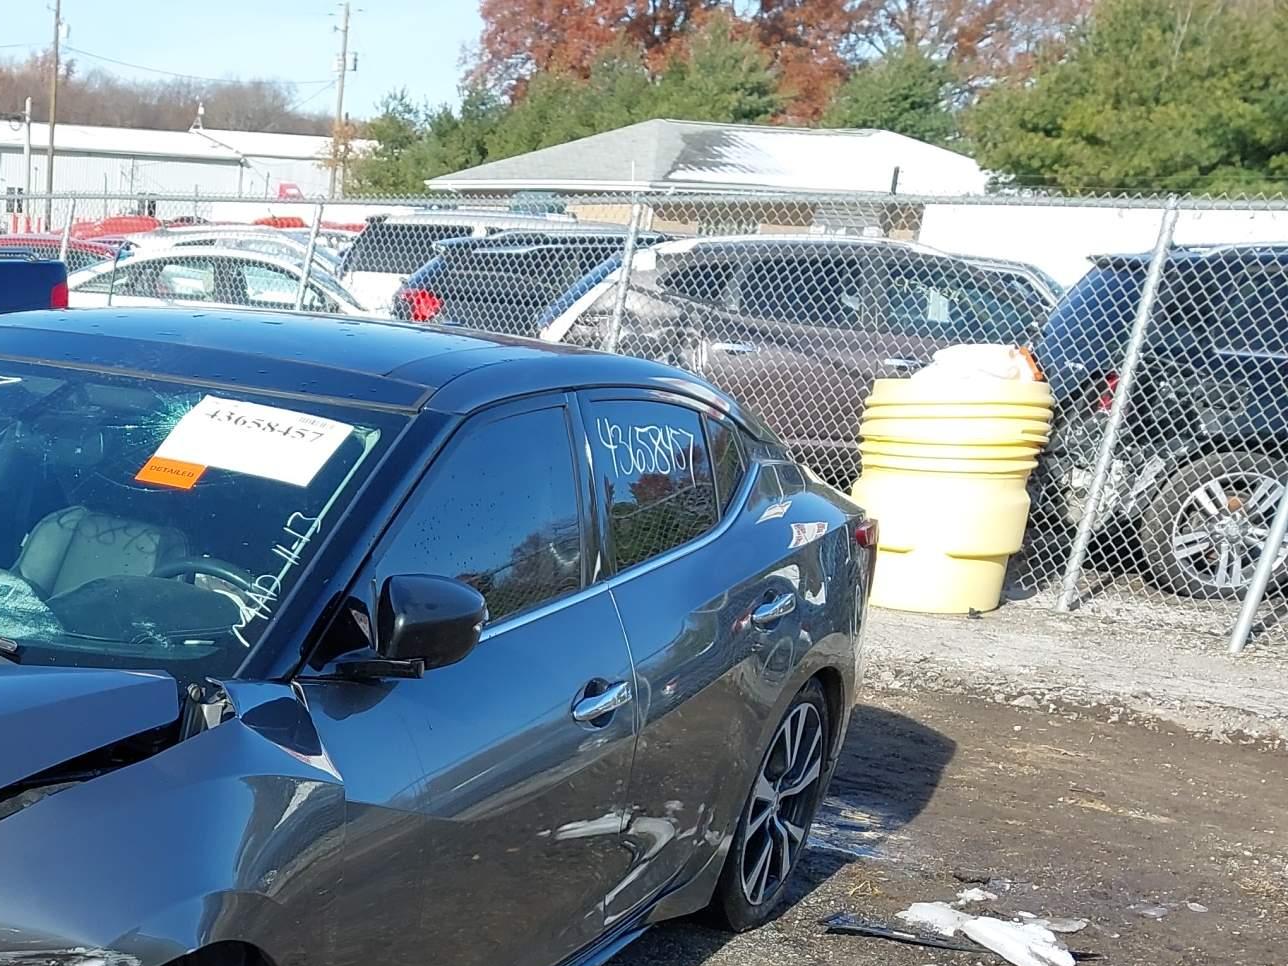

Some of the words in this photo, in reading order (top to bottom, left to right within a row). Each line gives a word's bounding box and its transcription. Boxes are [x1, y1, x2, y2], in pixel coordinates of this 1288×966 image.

[205, 409, 325, 443] 43658457
[596, 417, 696, 489] 43658457
[149, 464, 195, 478] DETAILED
